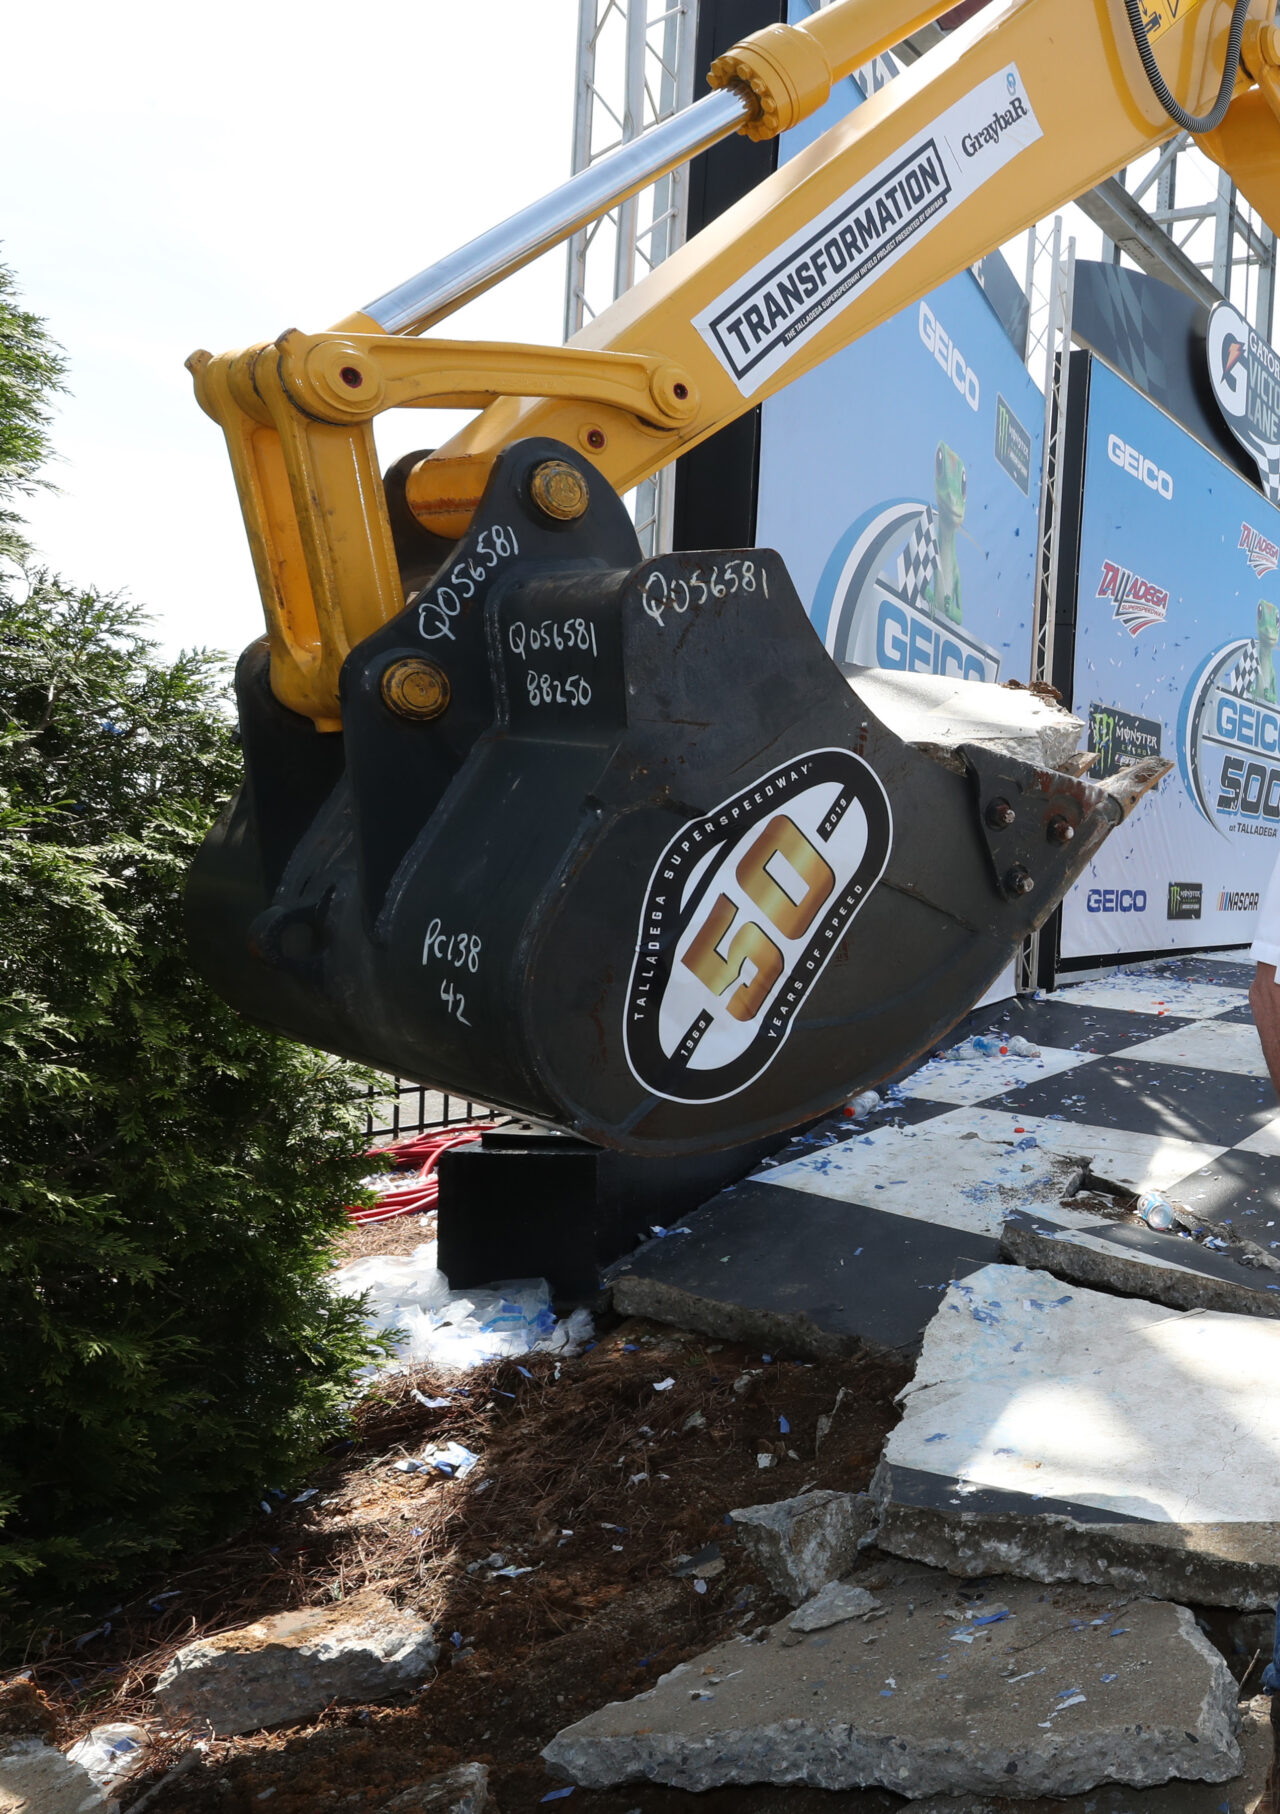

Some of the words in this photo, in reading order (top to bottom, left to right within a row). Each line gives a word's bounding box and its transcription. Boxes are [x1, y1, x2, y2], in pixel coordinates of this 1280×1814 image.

[726, 155, 942, 355] TRANSFORMATION
[784, 329, 796, 341] THE
[794, 306, 825, 333] TALLADEGA
[821, 271, 862, 310] SUPERSPEEDWAY
[858, 254, 879, 276] INFIELD
[876, 238, 898, 261] PROJECT
[895, 216, 922, 244] PRESENTED
[918, 211, 928, 222] BY
[924, 195, 946, 218] GRAYBAR
[918, 300, 980, 412] GEICO
[1247, 388, 1279, 442] LANE
[1107, 433, 1174, 500] GEICO
[418, 524, 519, 642] Q056581
[642, 558, 770, 627] Q056581
[1097, 561, 1169, 610] TALLADEGA
[509, 617, 599, 661] Q056581
[526, 668, 593, 708] 88250
[1115, 726, 1157, 749] MONSTER
[824, 797, 848, 833] 2019
[1237, 823, 1277, 838] TALLADEGA
[633, 893, 666, 1022] TALLADEGA
[663, 762, 814, 880] SUPERSPEEDWAY
[1086, 889, 1147, 914] GEICO
[1227, 891, 1260, 912] NASCAR
[680, 814, 836, 1023] 50
[767, 979, 804, 1040] YEARS
[806, 948, 822, 971] OF
[824, 883, 864, 940] SPEED
[440, 978, 473, 1027] 42
[679, 1018, 707, 1057] 1969
